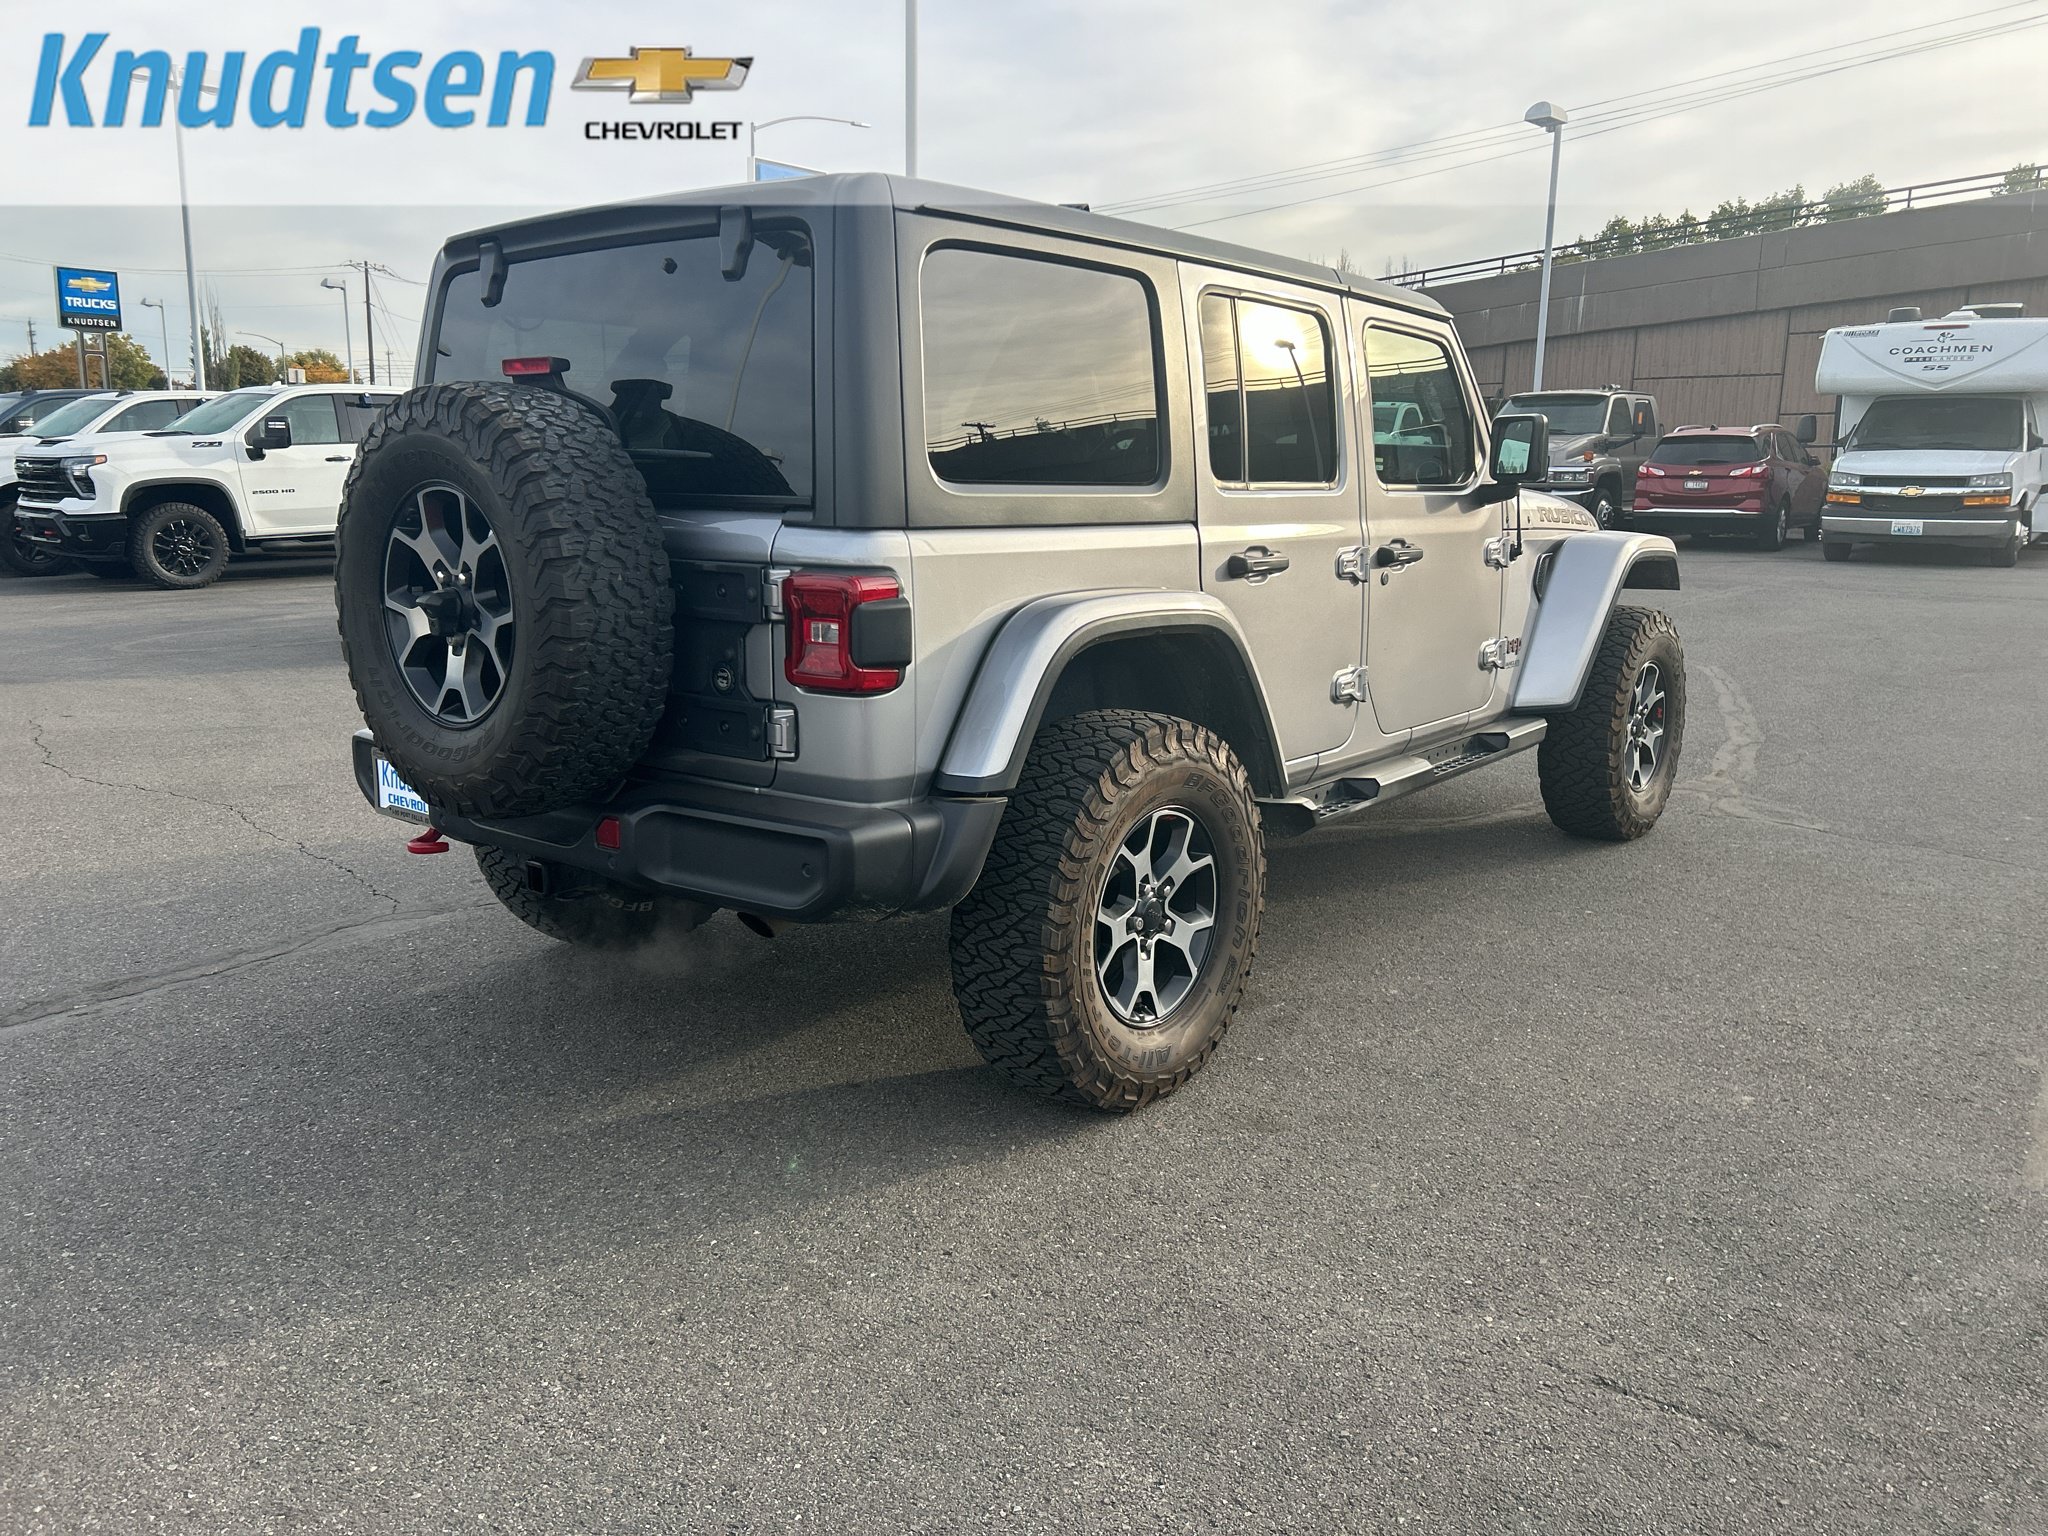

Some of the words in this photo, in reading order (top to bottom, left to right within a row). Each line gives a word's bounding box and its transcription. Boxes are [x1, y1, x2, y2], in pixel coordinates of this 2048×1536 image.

[64, 296, 117, 310] TRUCKS
[67, 317, 117, 327] KNUDTSEN
[1889, 345, 1993, 356] COACHMEN
[1537, 505, 1596, 528] RUBICON
[1183, 772, 1250, 949] BFGoodrich
